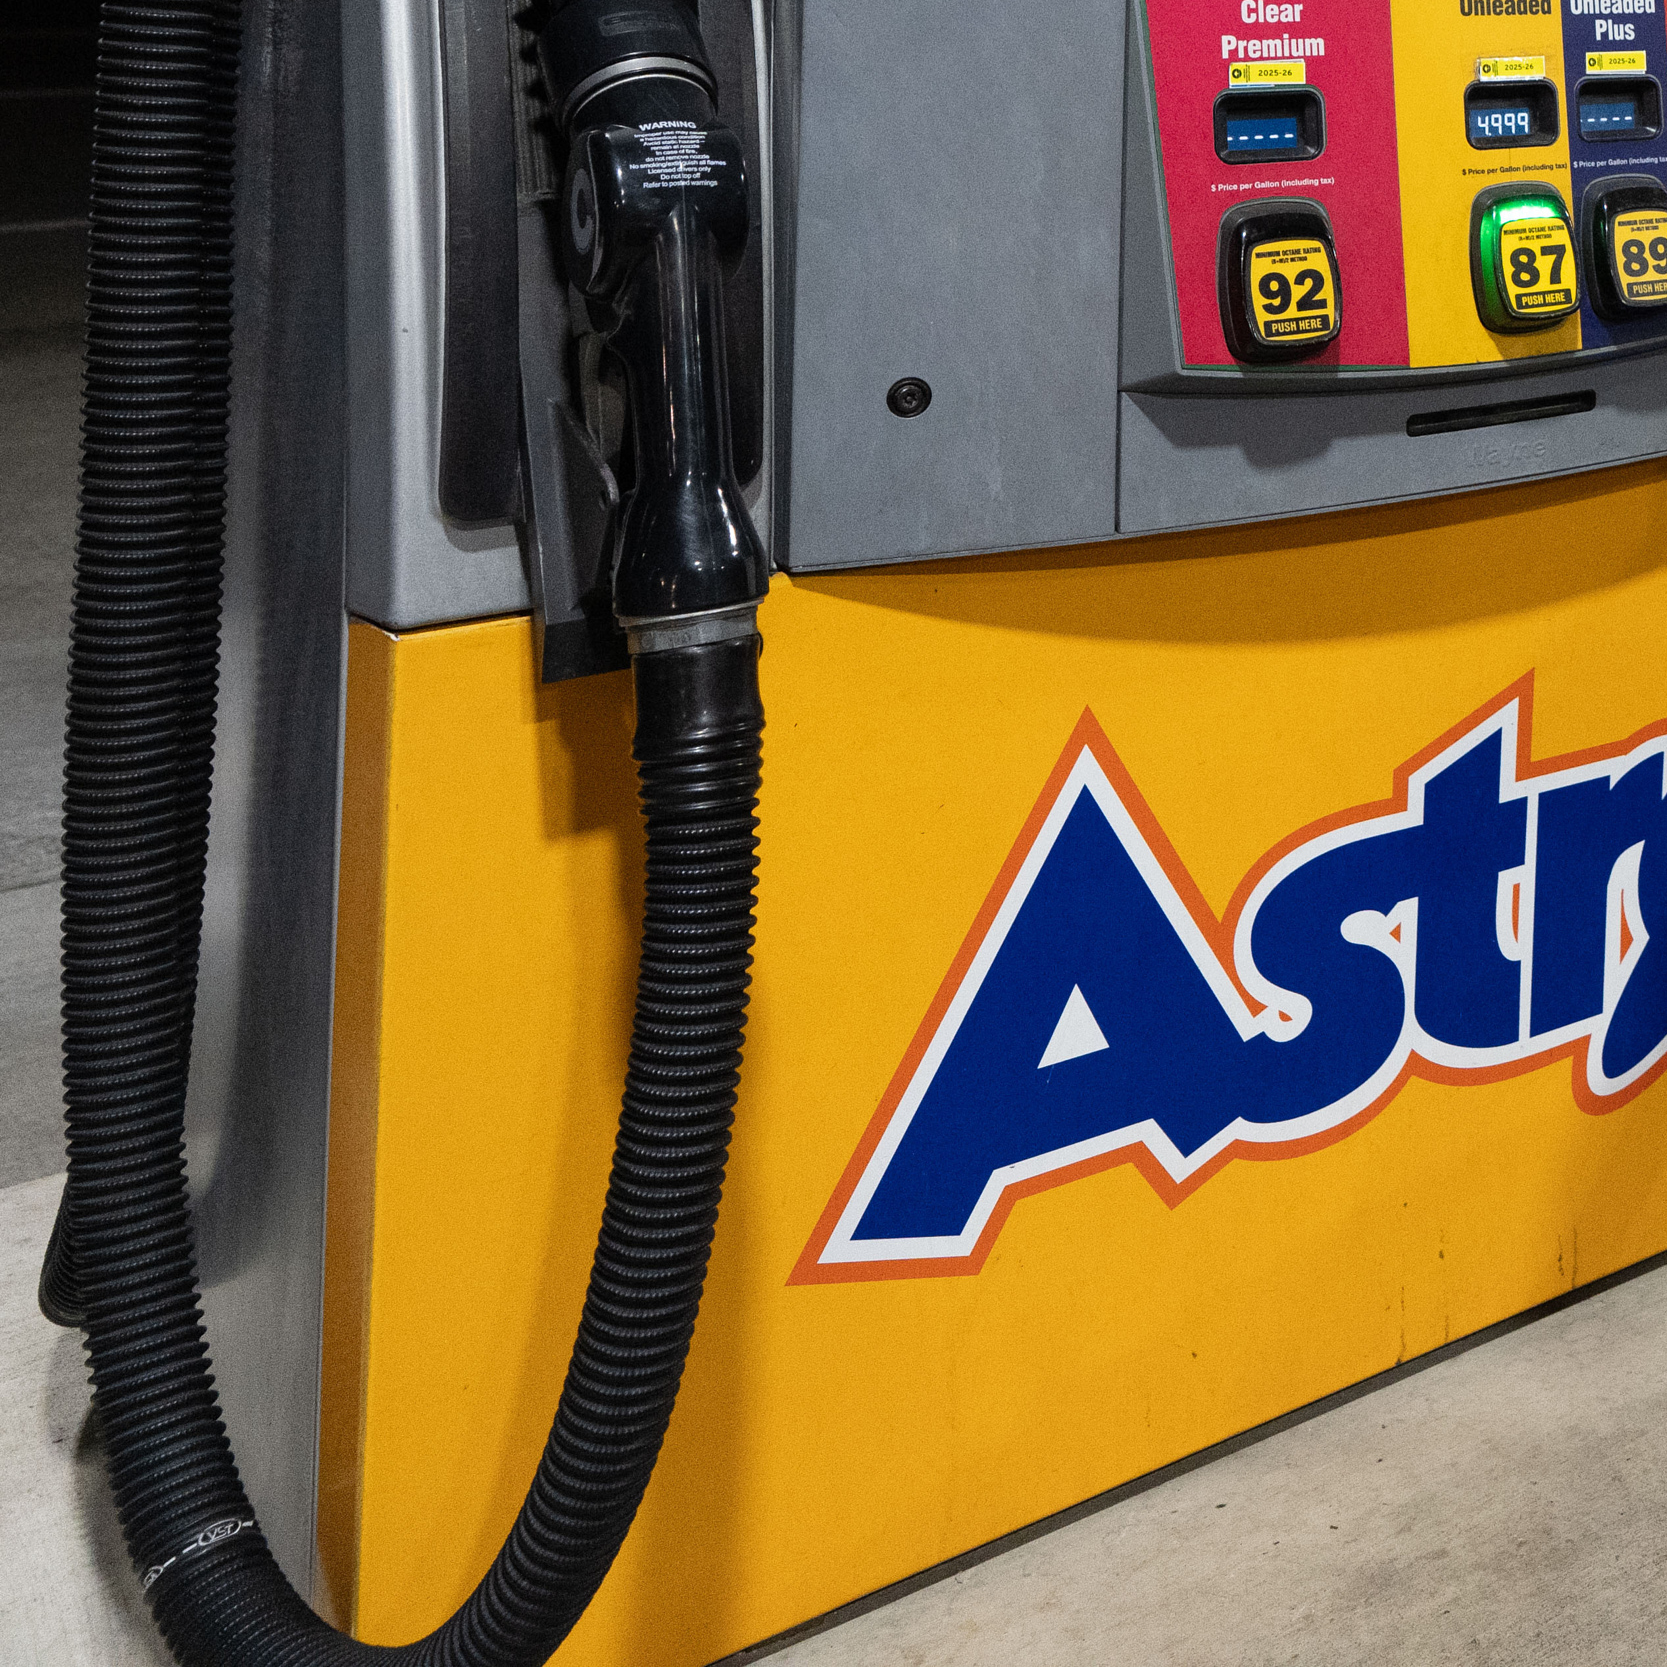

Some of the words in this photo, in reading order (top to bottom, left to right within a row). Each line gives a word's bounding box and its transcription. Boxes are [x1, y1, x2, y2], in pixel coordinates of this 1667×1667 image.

[1594, 18, 1636, 41] Plus
[1221, 33, 1325, 59] Premium
[1504, 63, 1535, 71] 2025-26
[1608, 57, 1636, 65] 2025-26
[1258, 68, 1293, 78] 2025-26
[638, 120, 697, 132] WARNING
[1468, 167, 1486, 176] Price
[1488, 167, 1498, 176] per
[1499, 165, 1521, 173] Gallon
[1522, 163, 1554, 173] (including
[1555, 162, 1568, 171] tax)
[1218, 183, 1238, 192] Price
[1239, 182, 1253, 192] per
[1254, 180, 1280, 189] Gallon
[1281, 178, 1319, 187] (including
[1320, 176, 1335, 186] tax)
[1509, 243, 1567, 289] 87
[1258, 268, 1328, 315] 92
[1632, 283, 1653, 295] PUSH
[1521, 294, 1544, 307] PUSH
[1545, 292, 1566, 304] HERE
[1271, 320, 1297, 334] PUSH
[1299, 317, 1323, 331] HERE
